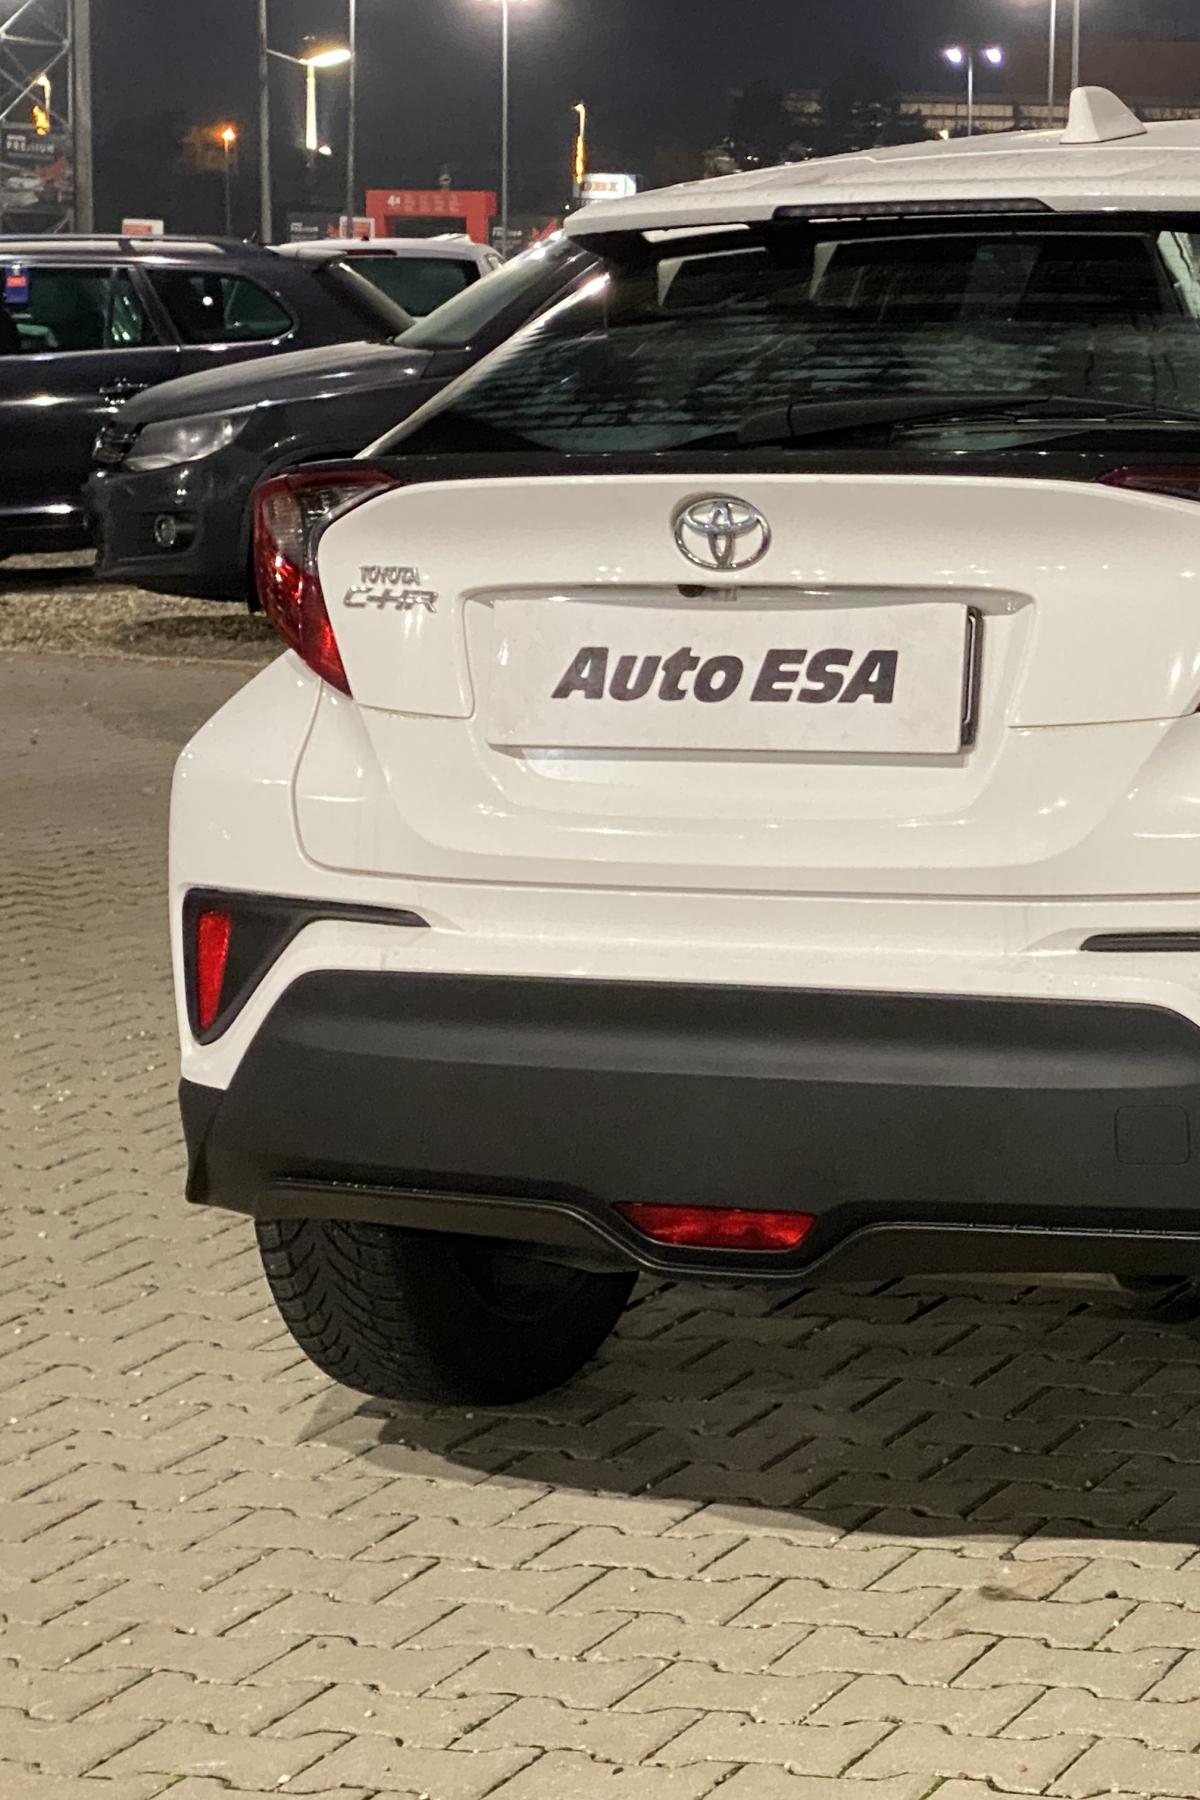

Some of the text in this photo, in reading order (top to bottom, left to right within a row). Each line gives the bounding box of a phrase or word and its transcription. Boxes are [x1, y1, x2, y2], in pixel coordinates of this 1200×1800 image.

[360, 565, 421, 586] TOYOTA
[343, 587, 438, 613] C-HR
[550, 646, 898, 704] Auto ESA
